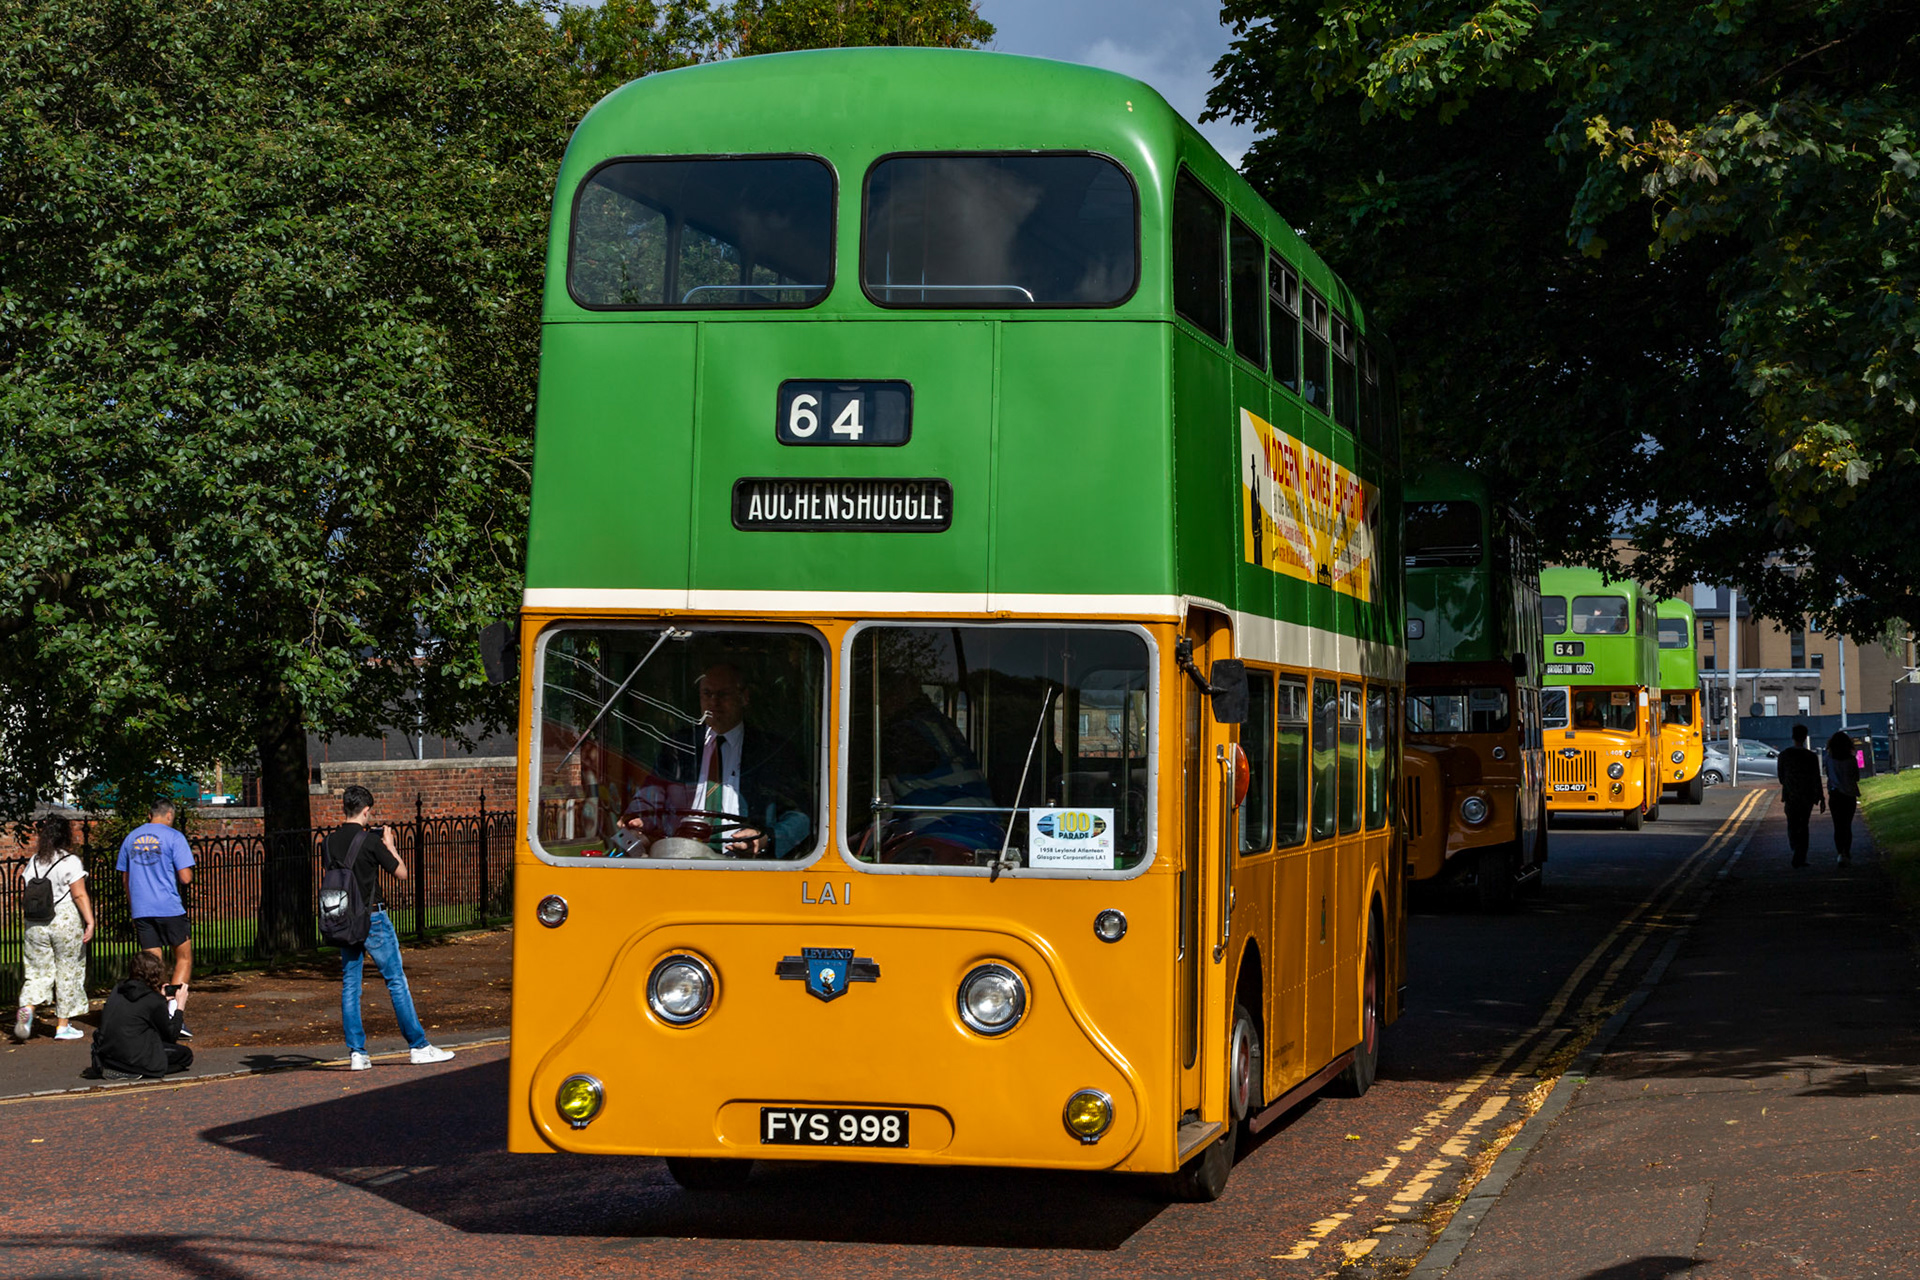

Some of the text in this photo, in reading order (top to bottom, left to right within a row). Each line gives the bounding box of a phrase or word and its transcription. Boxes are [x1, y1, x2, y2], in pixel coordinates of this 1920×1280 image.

[789, 393, 863, 440] 64
[1264, 433, 1300, 492] MODERN
[1304, 455, 1331, 507] HOMES
[748, 483, 945, 521] AUCHENSHUGGLE
[1555, 643, 1574, 655] 64
[1576, 664, 1592, 673] CROSS
[1570, 784, 1586, 792] 407
[1057, 811, 1090, 832] 100
[804, 948, 853, 960] LEYLAND
[767, 1112, 901, 1143] FYS 998
